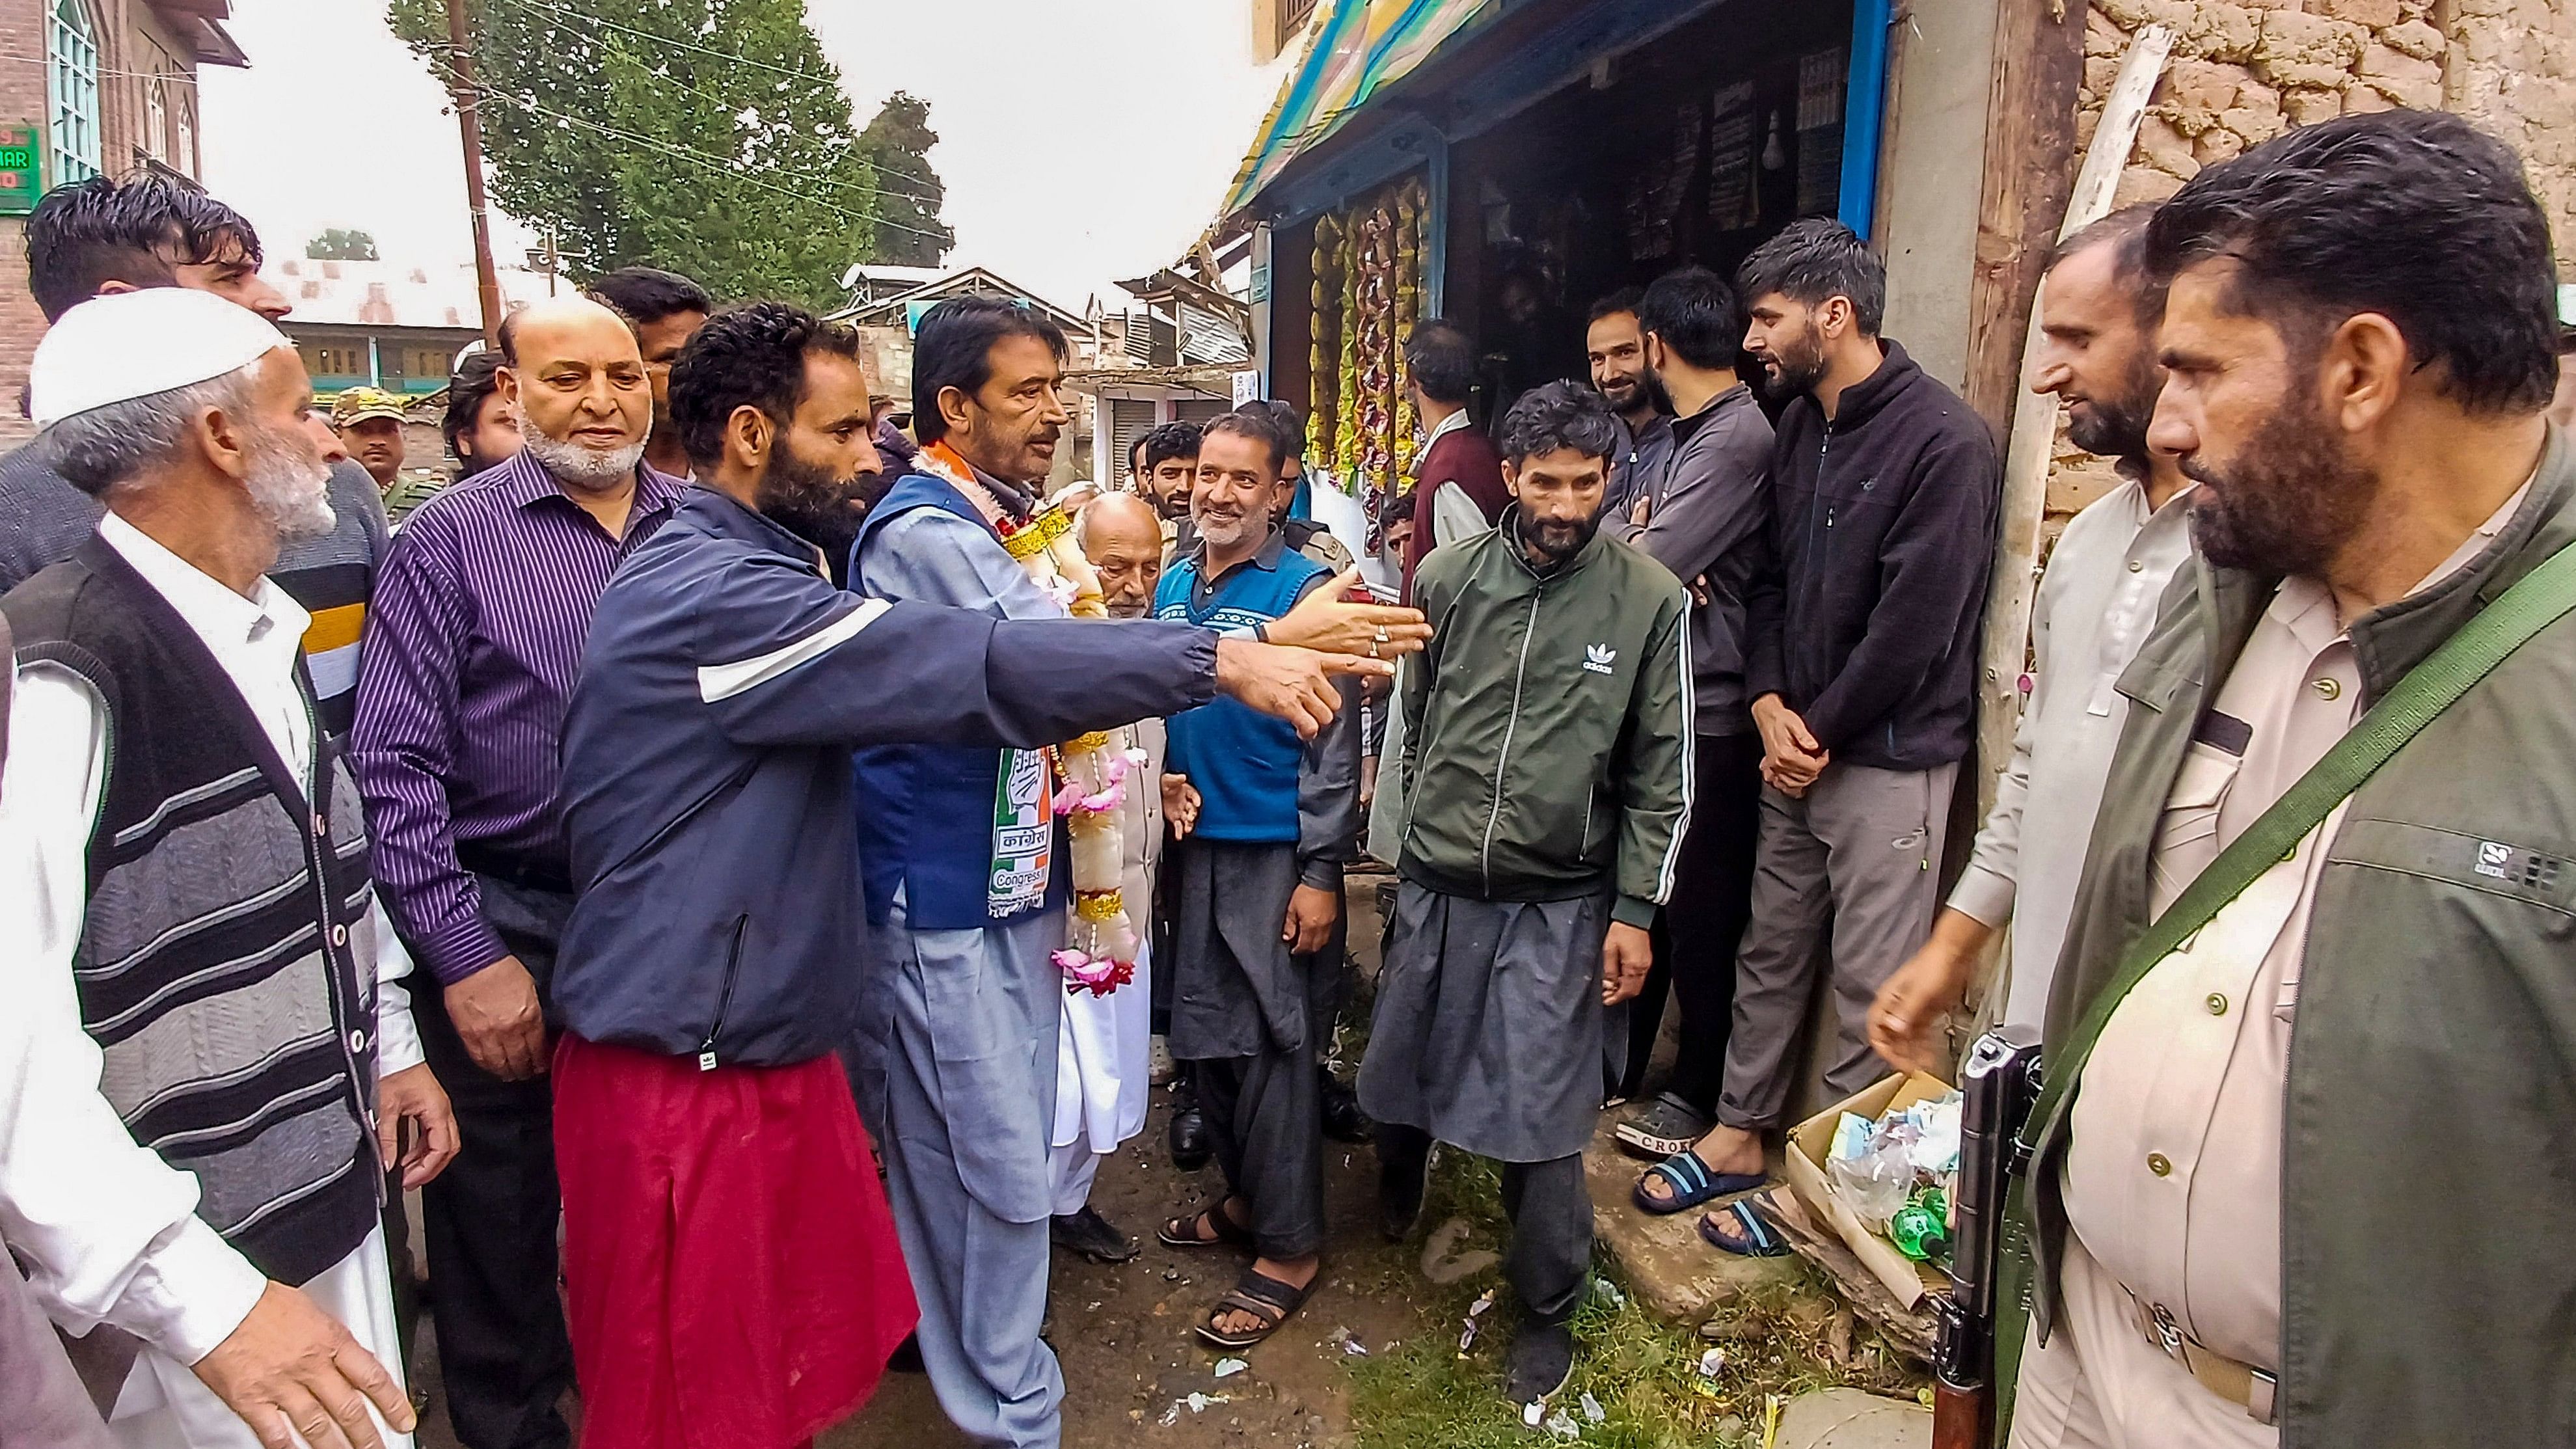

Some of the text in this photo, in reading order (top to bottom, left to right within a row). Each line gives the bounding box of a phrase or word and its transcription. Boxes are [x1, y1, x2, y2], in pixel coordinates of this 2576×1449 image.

[1583, 662, 1612, 674] adidas
[1003, 830, 1045, 847] कांग्रेस
[997, 871, 1040, 887] Congress
